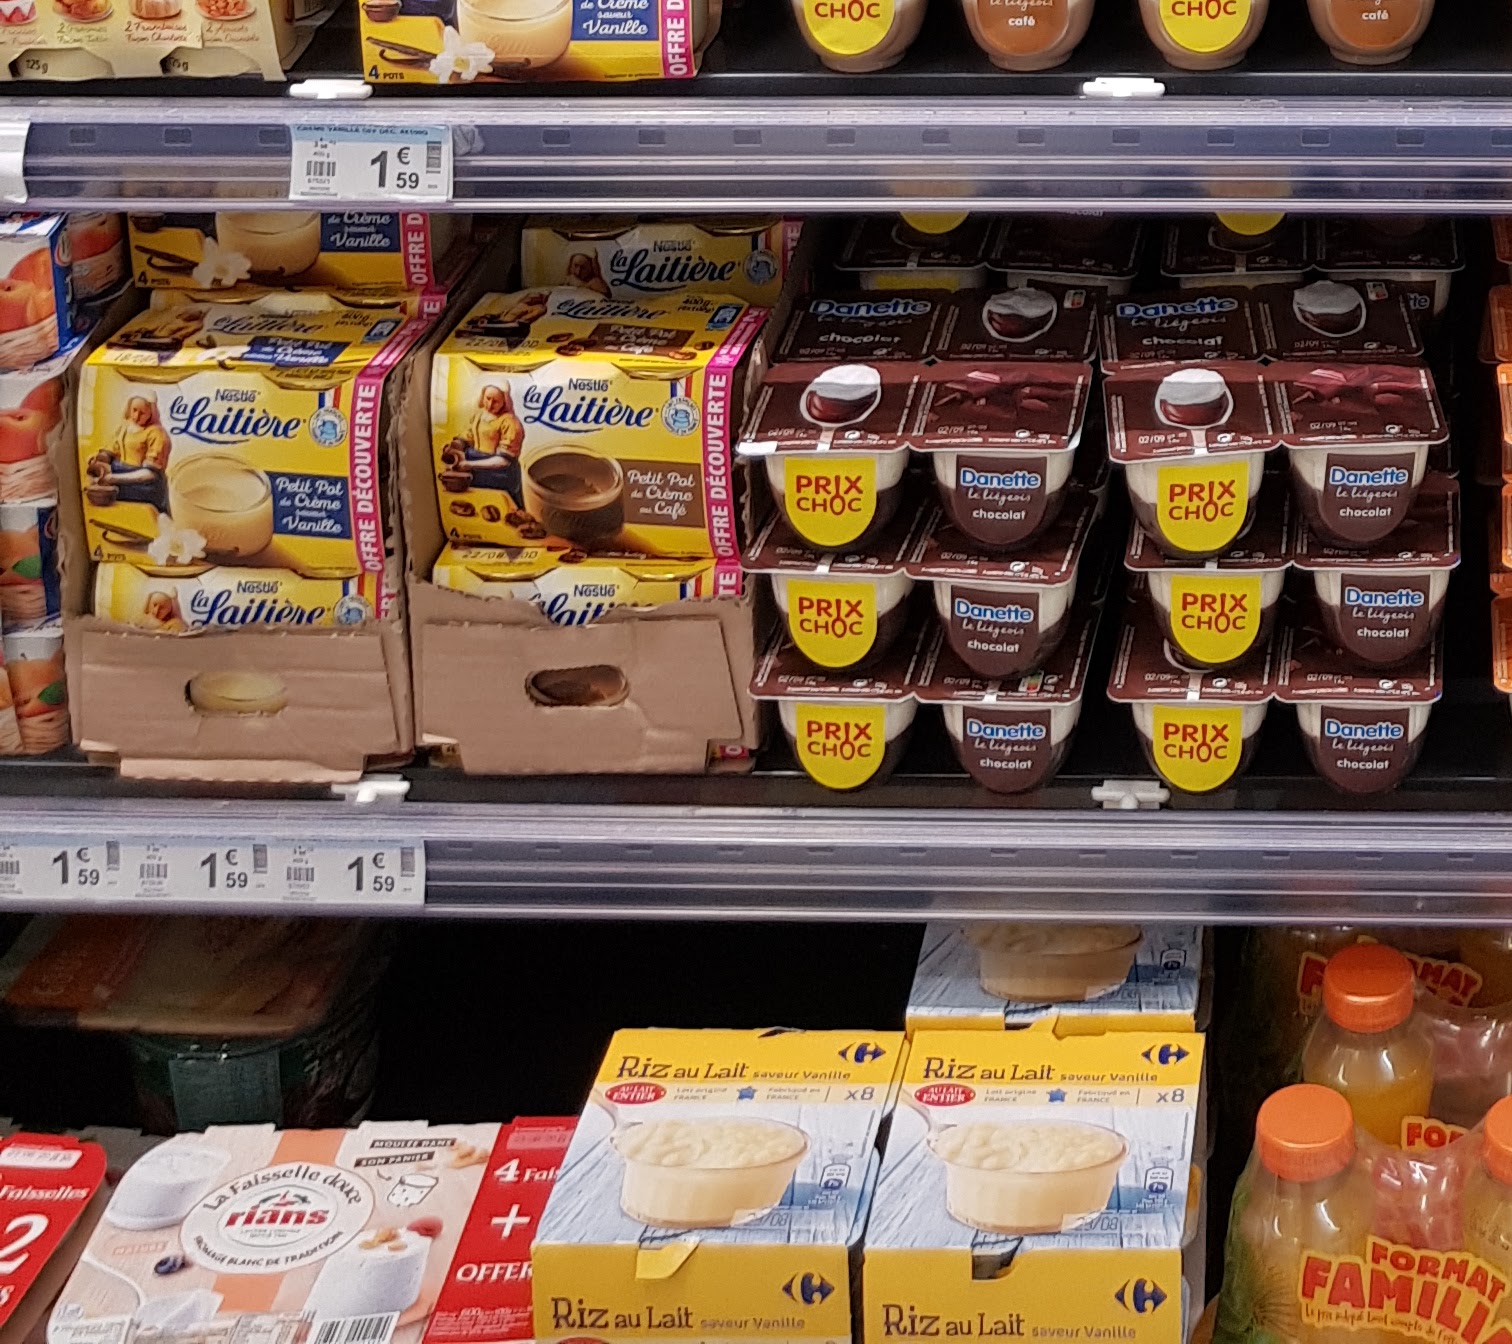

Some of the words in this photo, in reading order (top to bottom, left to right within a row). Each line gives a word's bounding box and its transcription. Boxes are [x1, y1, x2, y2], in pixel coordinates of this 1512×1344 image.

[371, 151, 388, 188] 1
[397, 147, 410, 165] €
[396, 172, 419, 189] 59
[1117, 297, 1239, 318] Danette
[524, 388, 654, 430] Laitière
[628, 471, 663, 486] Petit
[667, 472, 694, 487] Pot
[961, 469, 1042, 490] Danette
[647, 486, 693, 501] Crème
[654, 501, 686, 517] Café
[972, 508, 1026, 520] chocolat
[52, 850, 70, 884] 1
[78, 868, 100, 886] 59
[617, 1056, 673, 1079] Riz
[675, 1065, 699, 1079] au
[705, 1063, 750, 1079] Lait
[803, 1069, 851, 1081] Vanille
[845, 1087, 874, 1100] x8
[493, 1159, 521, 1182] 4
[1, 1185, 90, 1201] Faisselles
[224, 1206, 329, 1227] rians
[551, 1297, 609, 1330] Riz
[615, 1312, 644, 1328] au
[648, 1308, 693, 1329] Lait
